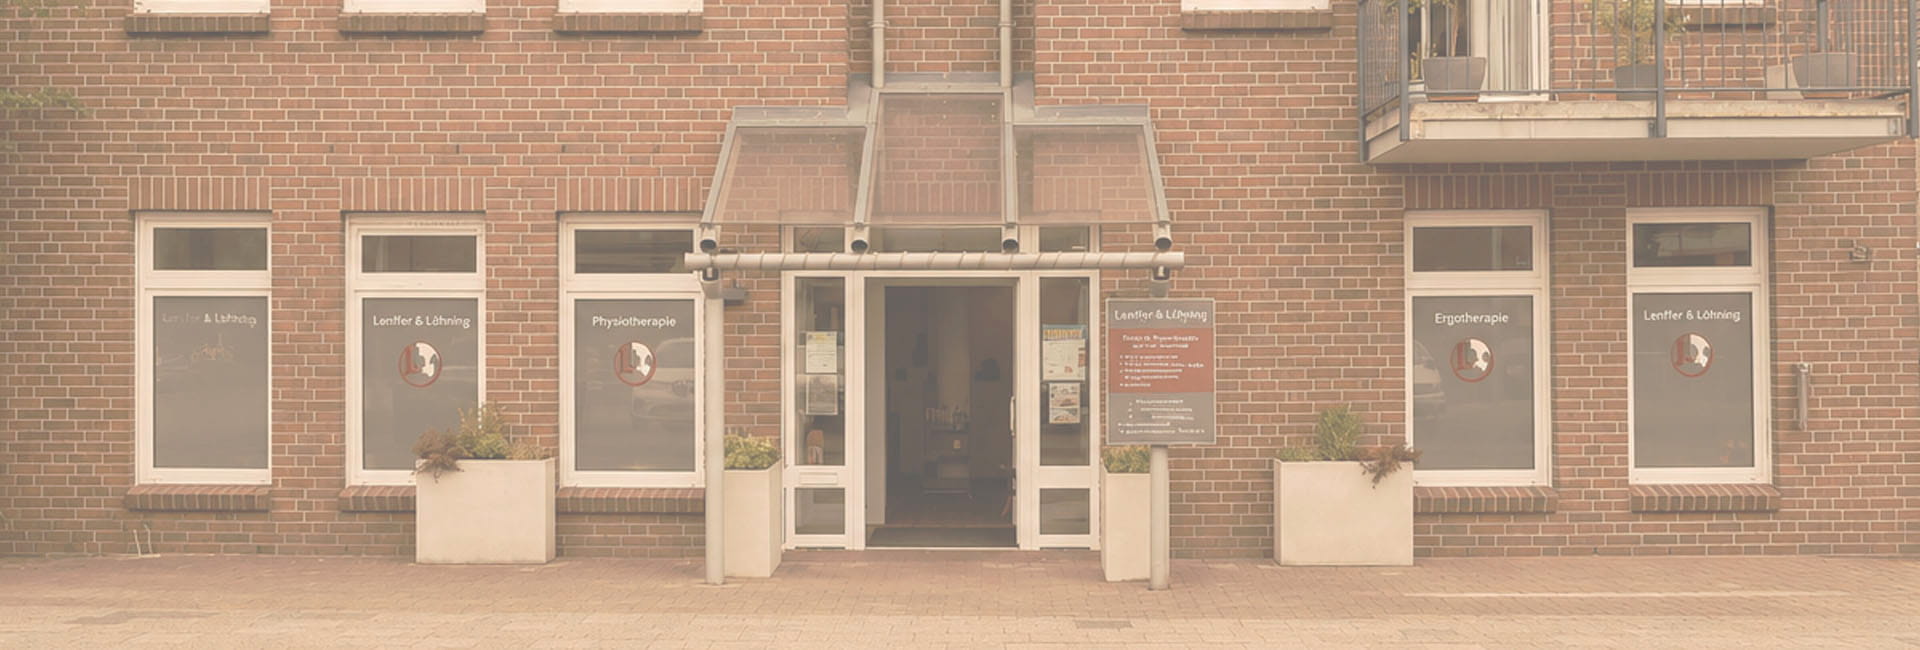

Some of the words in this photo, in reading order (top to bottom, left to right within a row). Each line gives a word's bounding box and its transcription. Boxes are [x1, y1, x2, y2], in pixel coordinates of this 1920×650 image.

[415, 315, 424, 326] &
[1434, 312, 1509, 326] Ergotherapie
[1686, 309, 1694, 321] &
[592, 315, 677, 329] Physiotherapie
